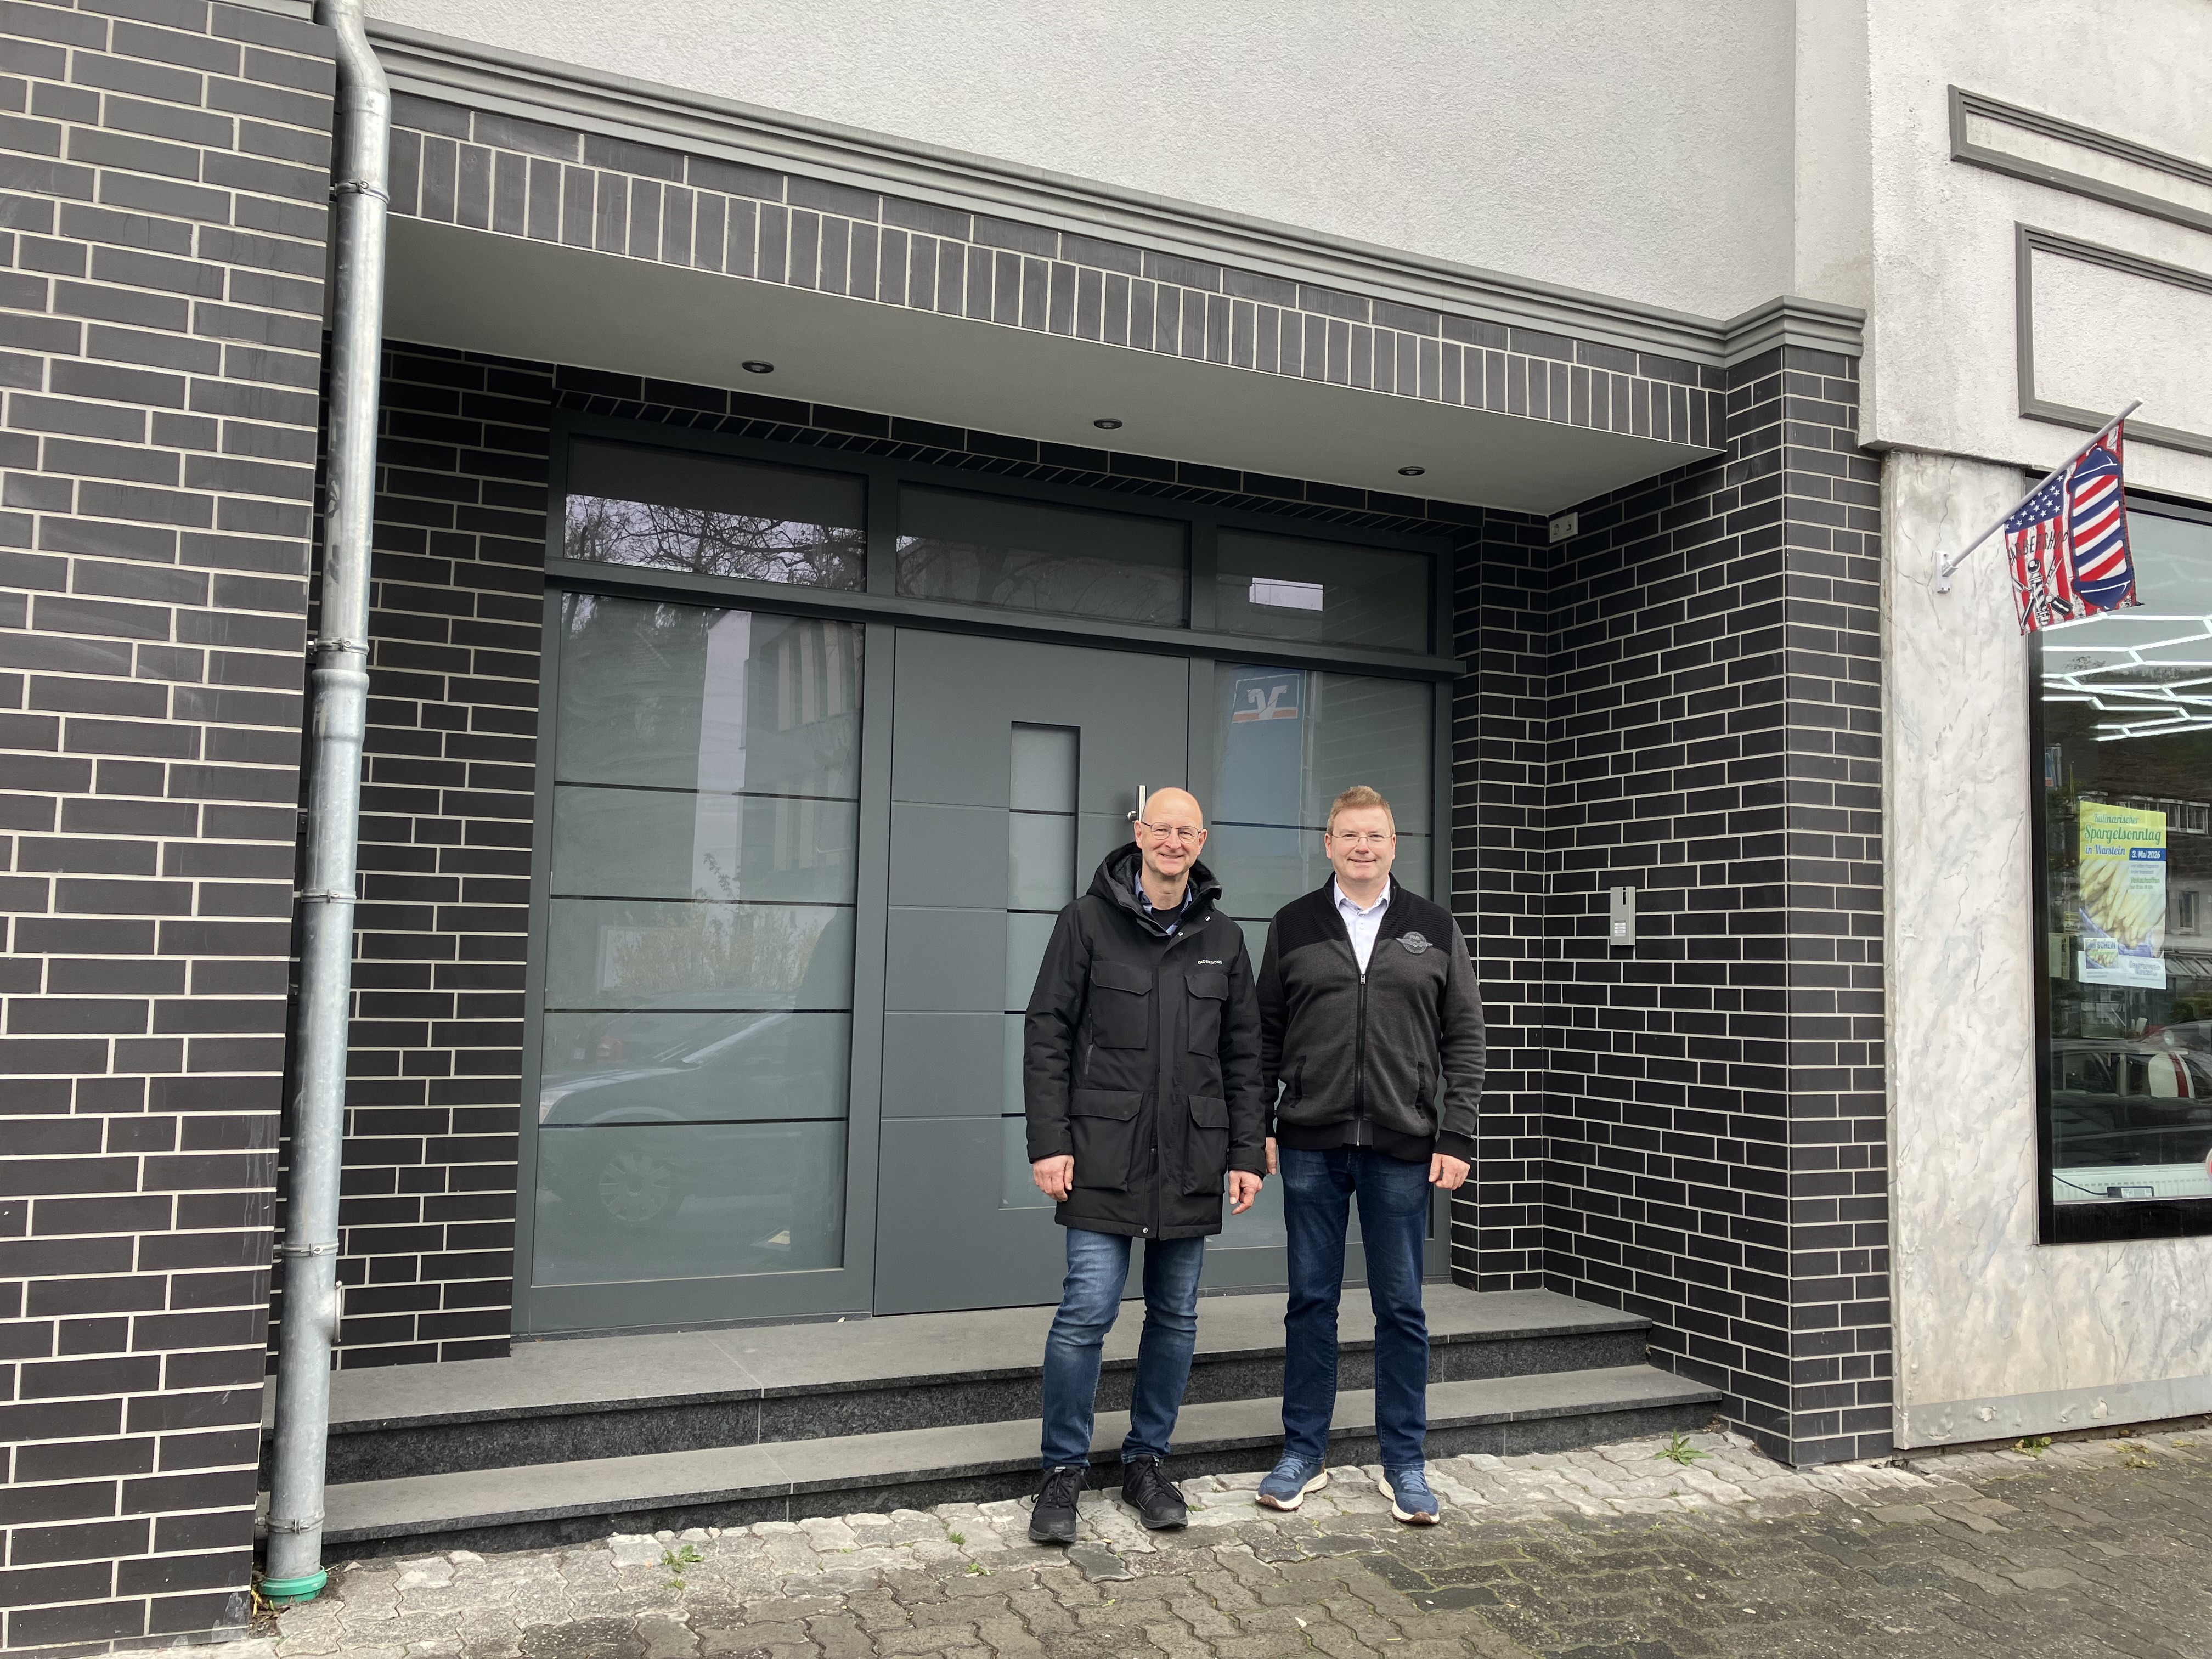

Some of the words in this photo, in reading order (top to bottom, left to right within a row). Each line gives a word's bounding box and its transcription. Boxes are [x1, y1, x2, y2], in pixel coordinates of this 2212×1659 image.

[2095, 813, 2139, 824] Kulinarischer
[2085, 825, 2161, 845] Spargelsonntag
[2085, 845, 2092, 854] in
[2094, 844, 2125, 855] Warstein
[2131, 850, 2137, 859] 3.
[2138, 850, 2147, 859] Mai
[2147, 851, 2161, 859] 2026
